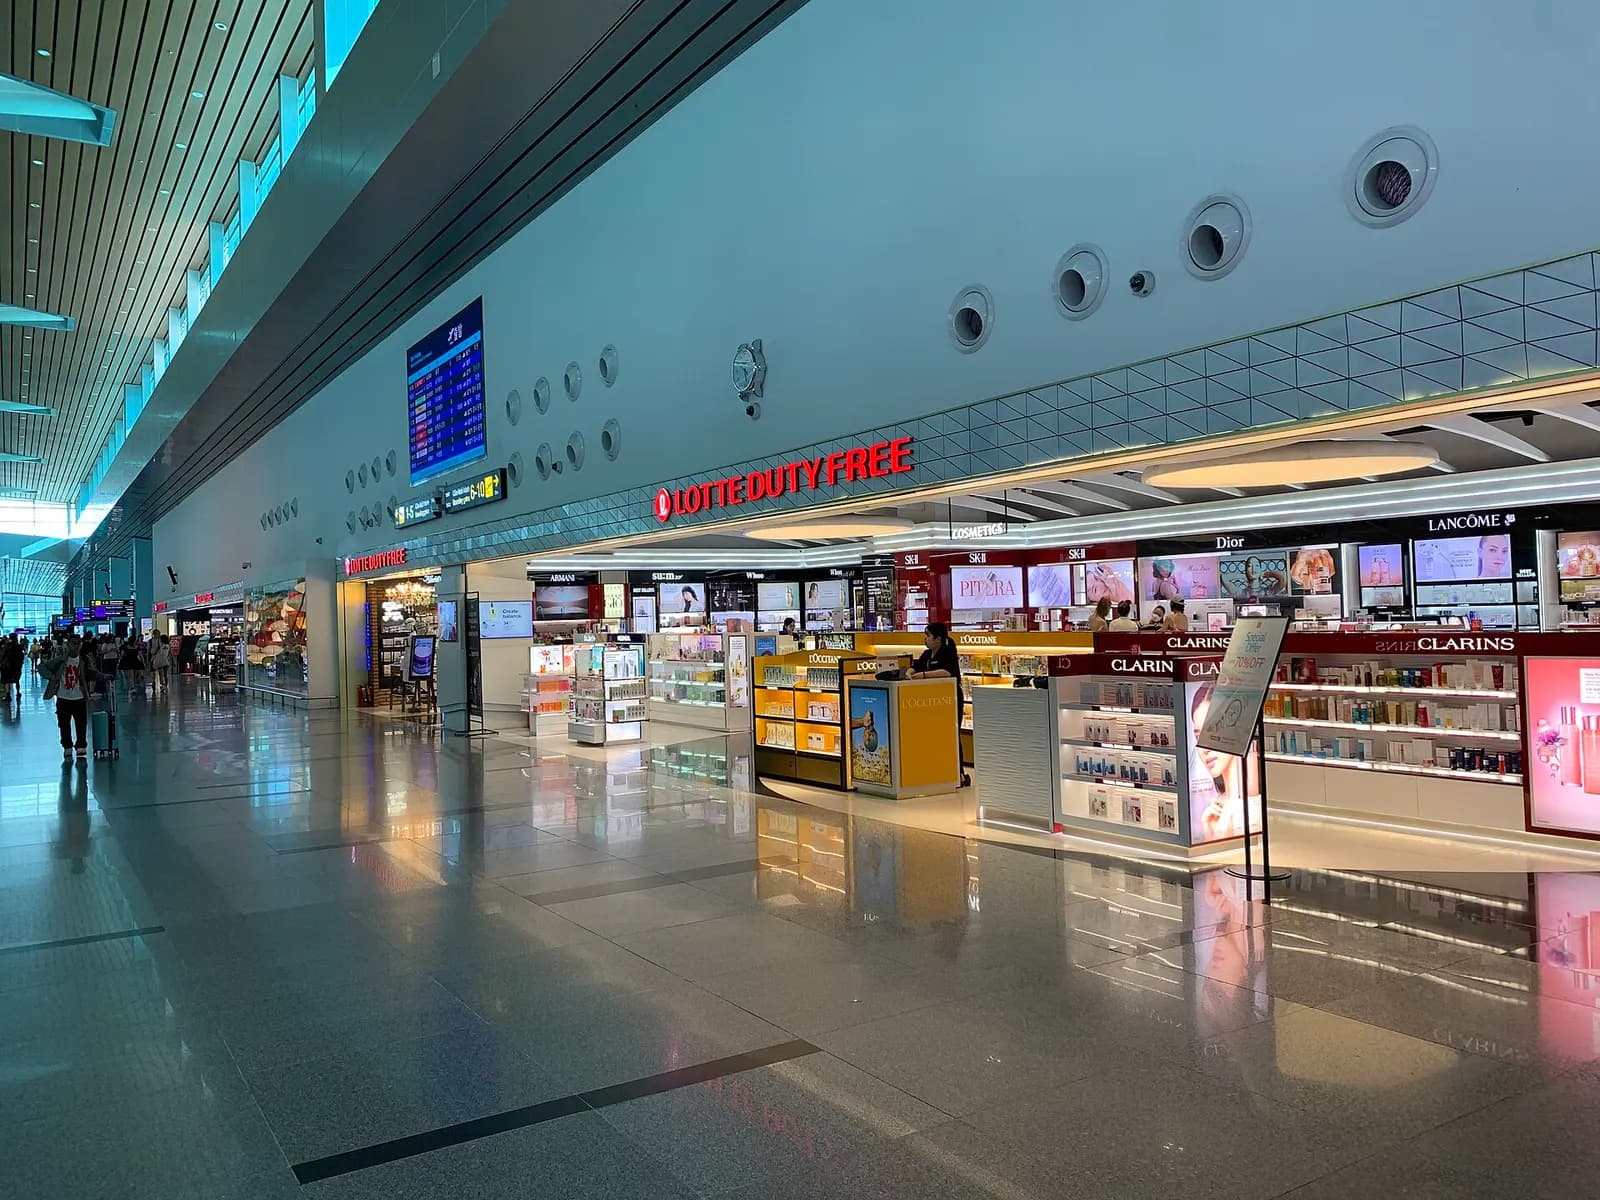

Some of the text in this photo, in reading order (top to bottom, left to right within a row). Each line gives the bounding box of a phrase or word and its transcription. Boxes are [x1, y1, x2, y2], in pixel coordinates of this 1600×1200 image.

[674, 436, 914, 514] LOTTE DUTY FREE
[470, 481, 485, 500] 6-10
[1428, 513, 1501, 532] LANCÔME
[951, 523, 1004, 540] COSMETICS
[1215, 536, 1245, 549] Dior
[351, 547, 406, 574] LOTTE DUTY FREE
[904, 554, 919, 565] SK-II
[969, 552, 986, 564] SK-II
[1068, 548, 1086, 560] SK-II
[960, 635, 997, 645] L'OCCITANE
[1167, 637, 1232, 649] CLARINS
[1417, 637, 1515, 650] CLARINS
[808, 653, 841, 664] L'OCCITAN
[856, 661, 877, 671] L'OCC
[1111, 658, 1174, 673] CLARIN
